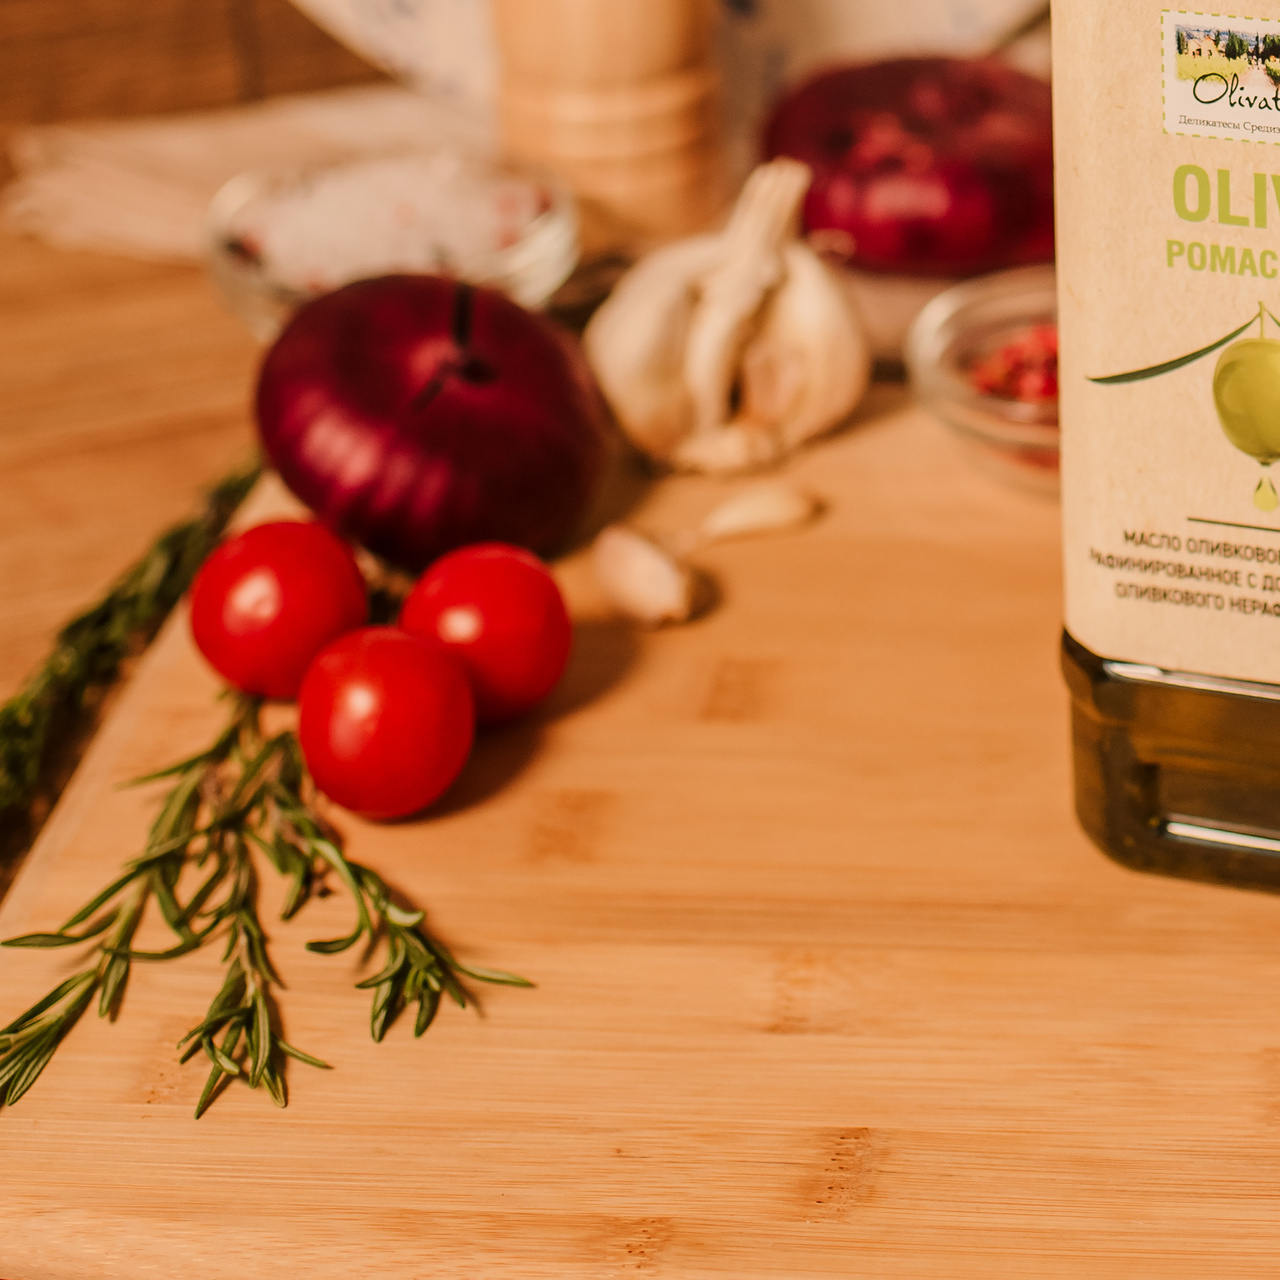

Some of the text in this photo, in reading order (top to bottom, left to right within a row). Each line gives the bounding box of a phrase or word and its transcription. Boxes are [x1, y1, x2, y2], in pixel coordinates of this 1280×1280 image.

[1178, 114, 1240, 130] Деликатесы
[1124, 530, 1182, 552] МАСЛО
[1247, 572, 1258, 589] С
[1115, 582, 1225, 611] ОЛИВКОВОГО
